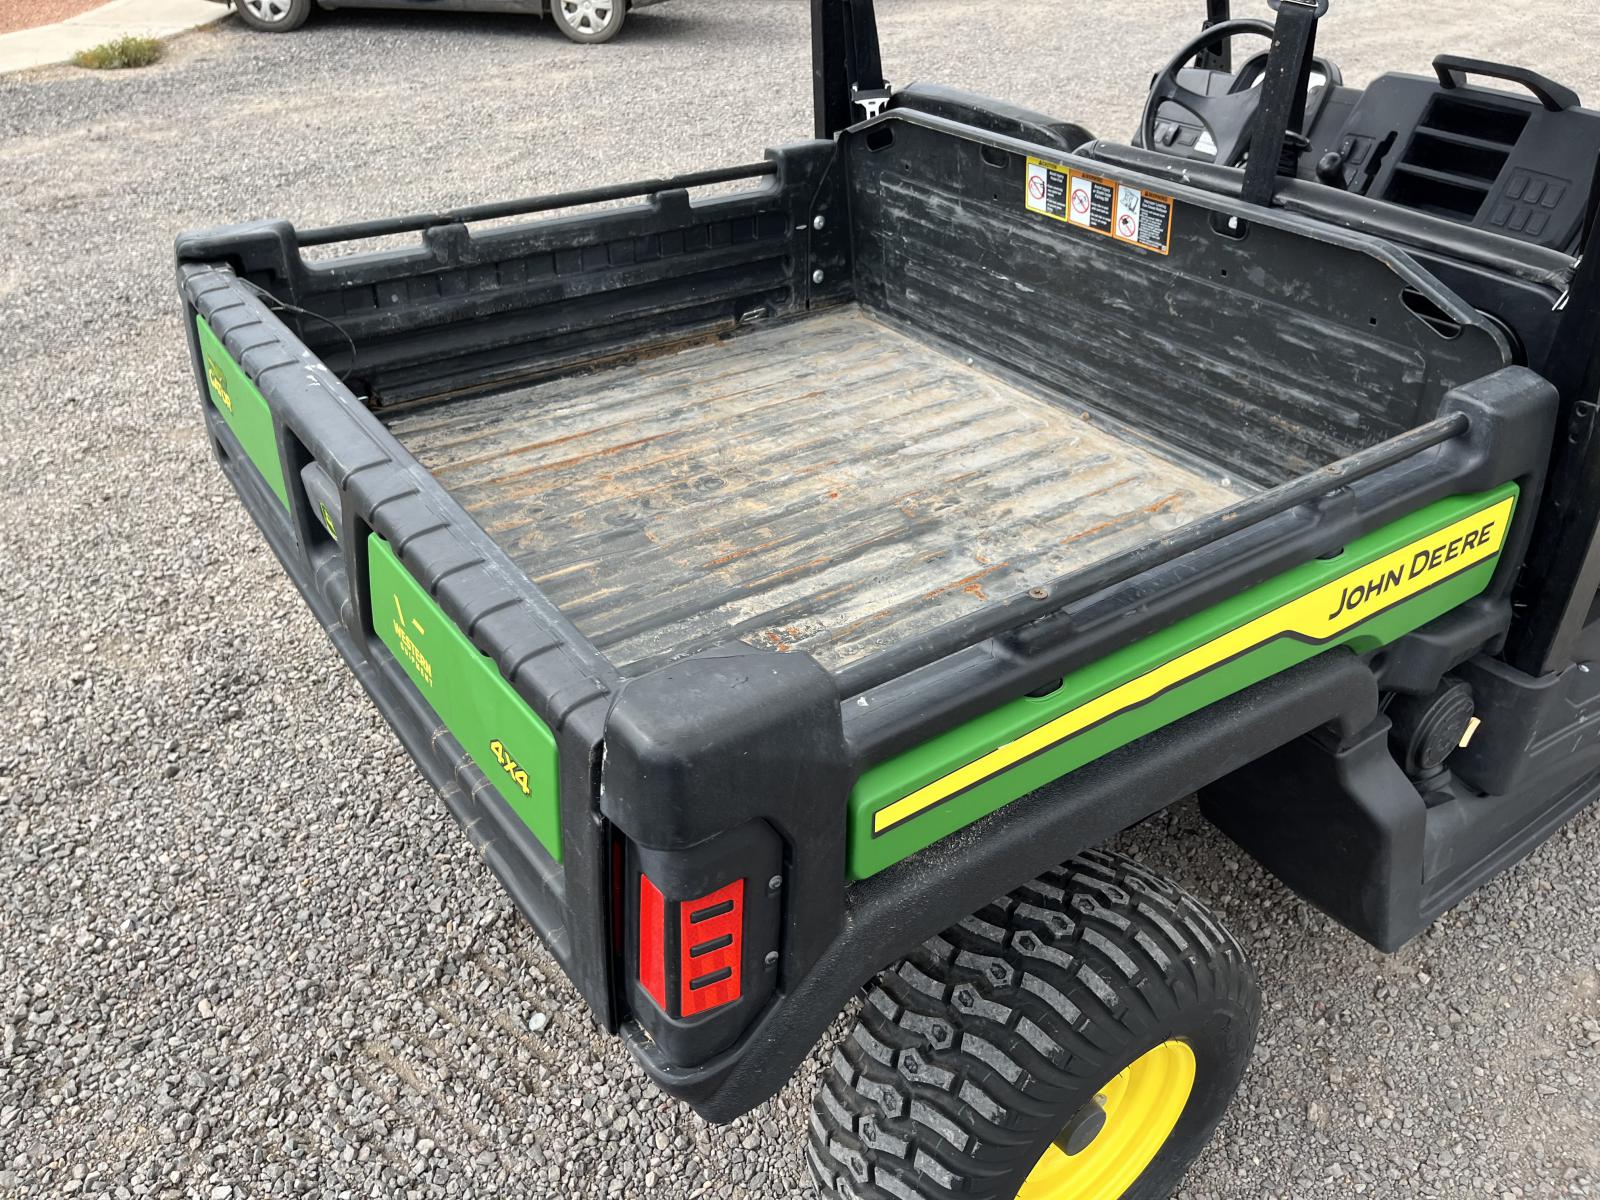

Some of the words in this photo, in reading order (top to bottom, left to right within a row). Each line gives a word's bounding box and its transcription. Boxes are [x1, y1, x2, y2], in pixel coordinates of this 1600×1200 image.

[1328, 564, 1405, 621] JOHN
[1407, 521, 1495, 581] DEERE
[393, 618, 433, 679] WESTERN
